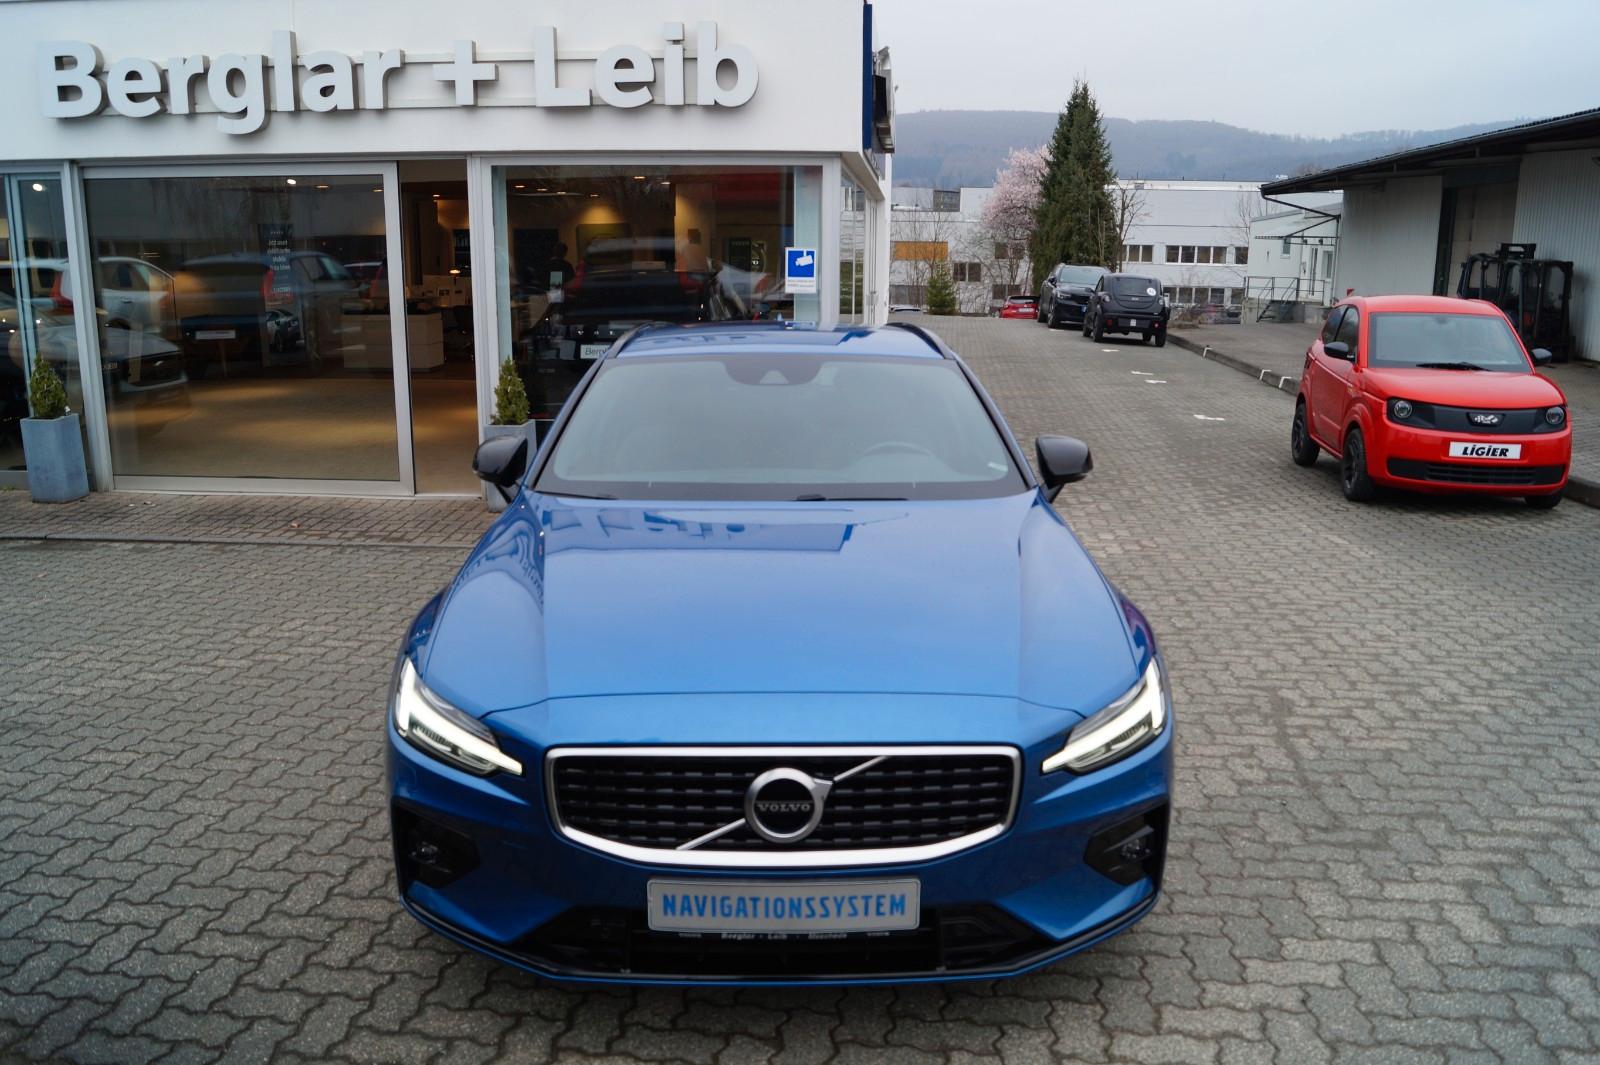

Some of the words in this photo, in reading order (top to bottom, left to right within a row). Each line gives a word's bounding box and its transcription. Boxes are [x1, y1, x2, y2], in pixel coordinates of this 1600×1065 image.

[42, 30, 405, 135] Berglar
[433, 39, 499, 106] +
[534, 21, 760, 109] Leib
[757, 803, 811, 812] VOLVO
[662, 893, 906, 919] NAVIGATIONSSYSTEM
